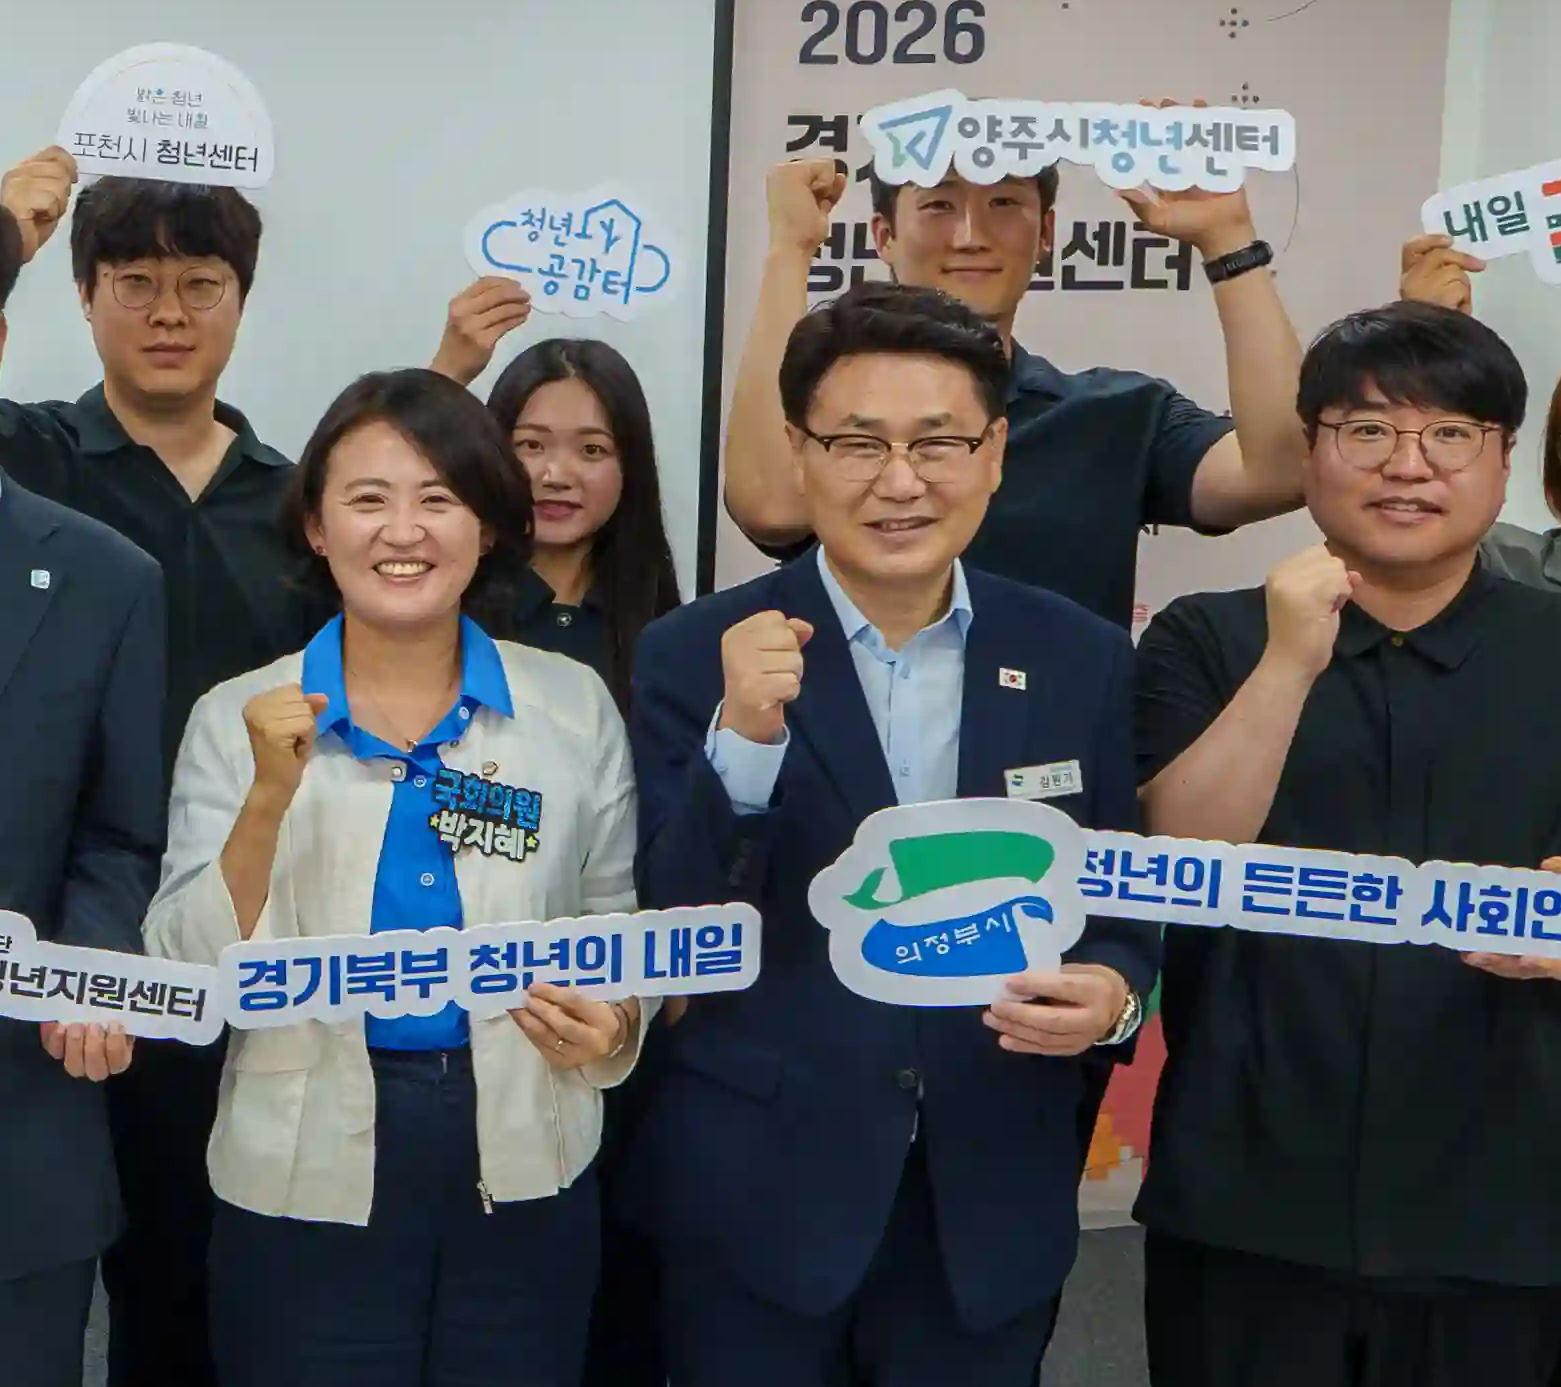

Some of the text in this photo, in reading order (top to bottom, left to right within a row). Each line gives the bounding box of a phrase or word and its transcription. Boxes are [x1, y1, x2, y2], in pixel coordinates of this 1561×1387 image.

[798, 0, 986, 64] 2026
[72, 132, 259, 172] 포천시 청년센터
[958, 116, 1280, 175] 양주시청년센터
[520, 207, 574, 247] 청년
[1442, 191, 1531, 244] 내일
[434, 769, 542, 830] 국회의원
[439, 810, 526, 860] 박지혜
[1242, 865, 1403, 925] 든든한
[895, 912, 1012, 964] 의정부시
[238, 922, 743, 1012] 경기북부 청년의 내일
